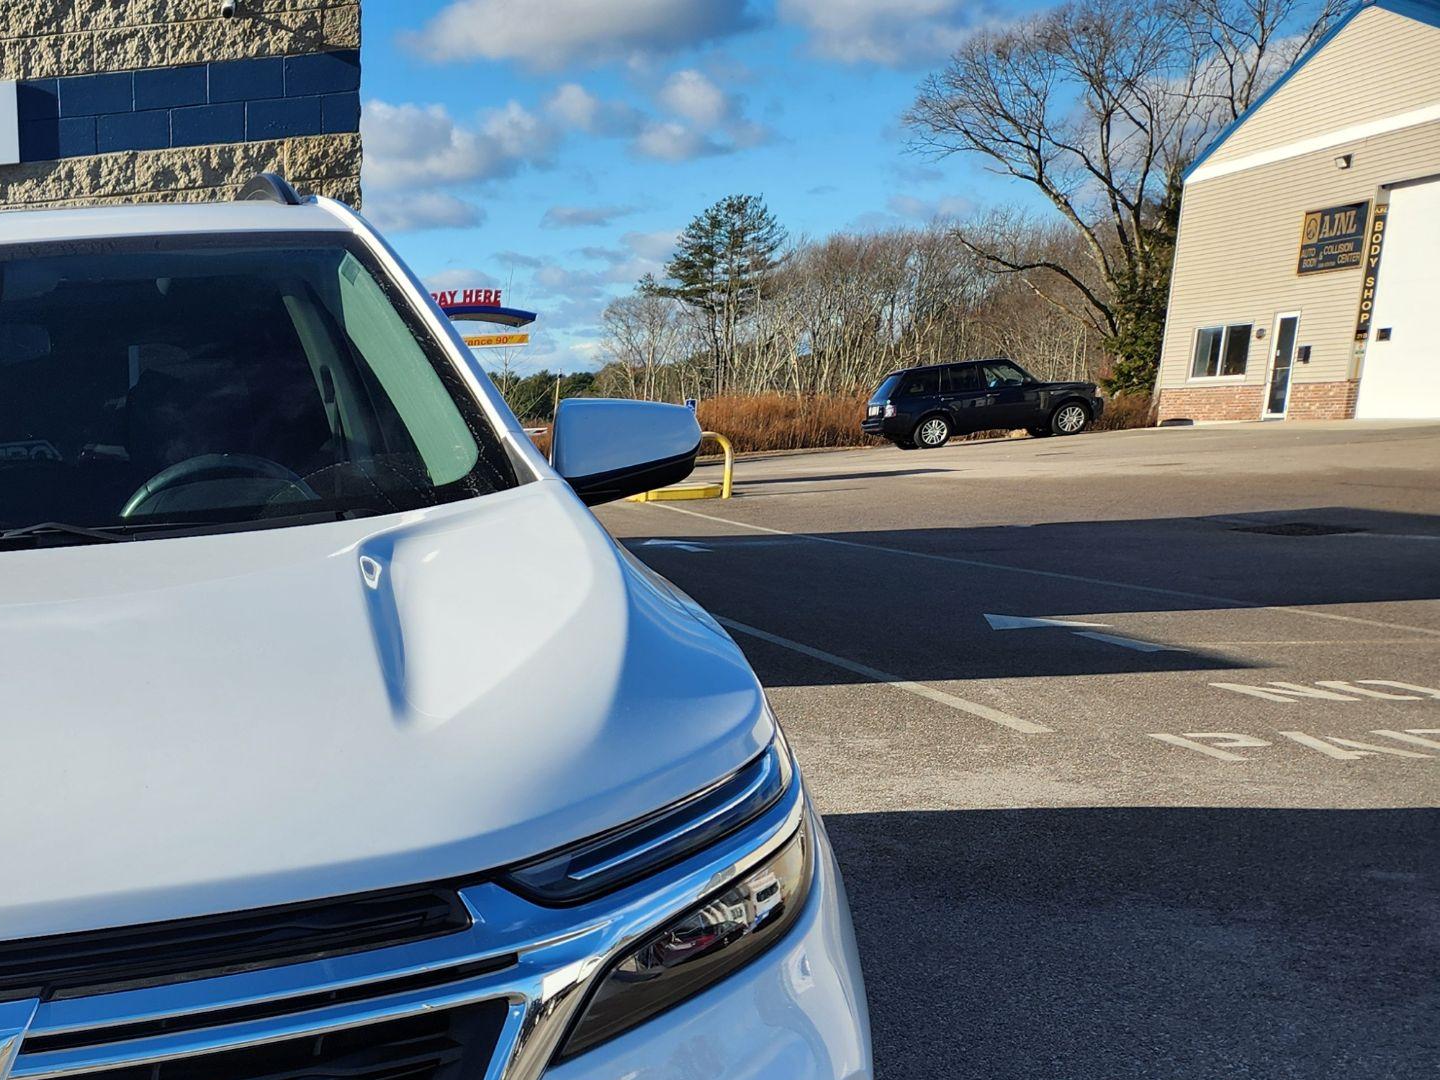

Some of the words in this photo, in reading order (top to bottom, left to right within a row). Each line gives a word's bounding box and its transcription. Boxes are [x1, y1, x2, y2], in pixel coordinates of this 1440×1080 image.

[1319, 210, 1357, 238] AJNL
[1324, 242, 1354, 255] COLLISION
[1370, 221, 1384, 268] BODY
[463, 289, 502, 305] HERE
[1361, 277, 1374, 323] SHOP
